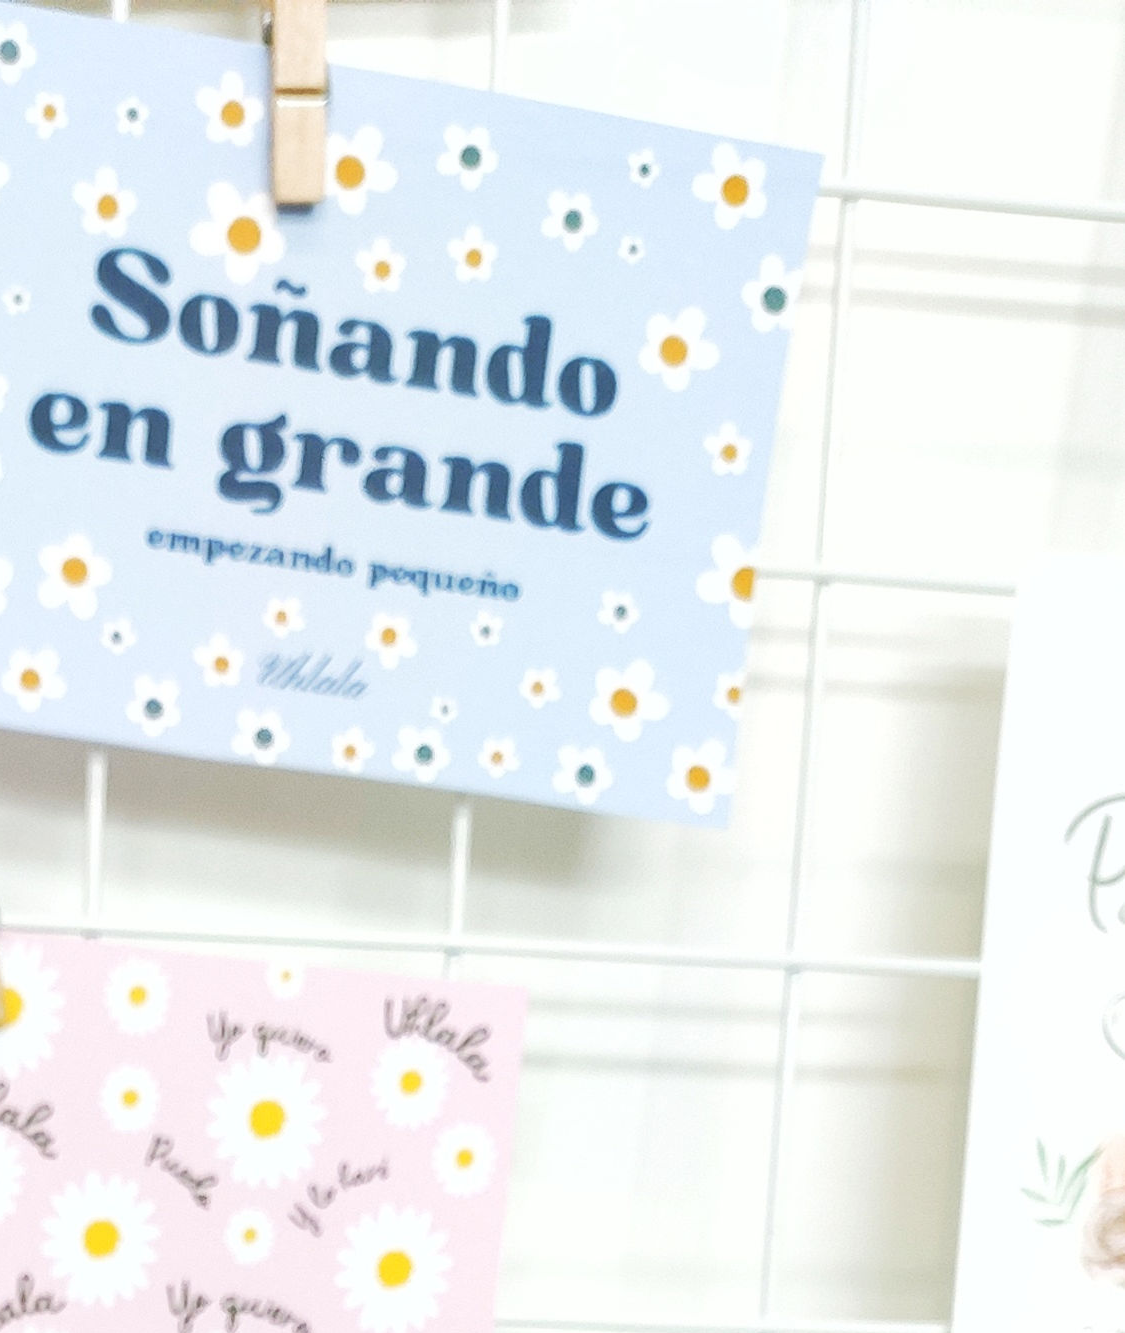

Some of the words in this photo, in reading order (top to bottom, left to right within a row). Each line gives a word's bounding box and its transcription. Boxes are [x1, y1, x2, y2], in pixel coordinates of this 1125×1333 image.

[88, 246, 619, 420] Soñando
[27, 388, 174, 470] en
[217, 411, 651, 542] grande
[145, 526, 357, 578] empezando
[367, 560, 521, 602] pequeño
